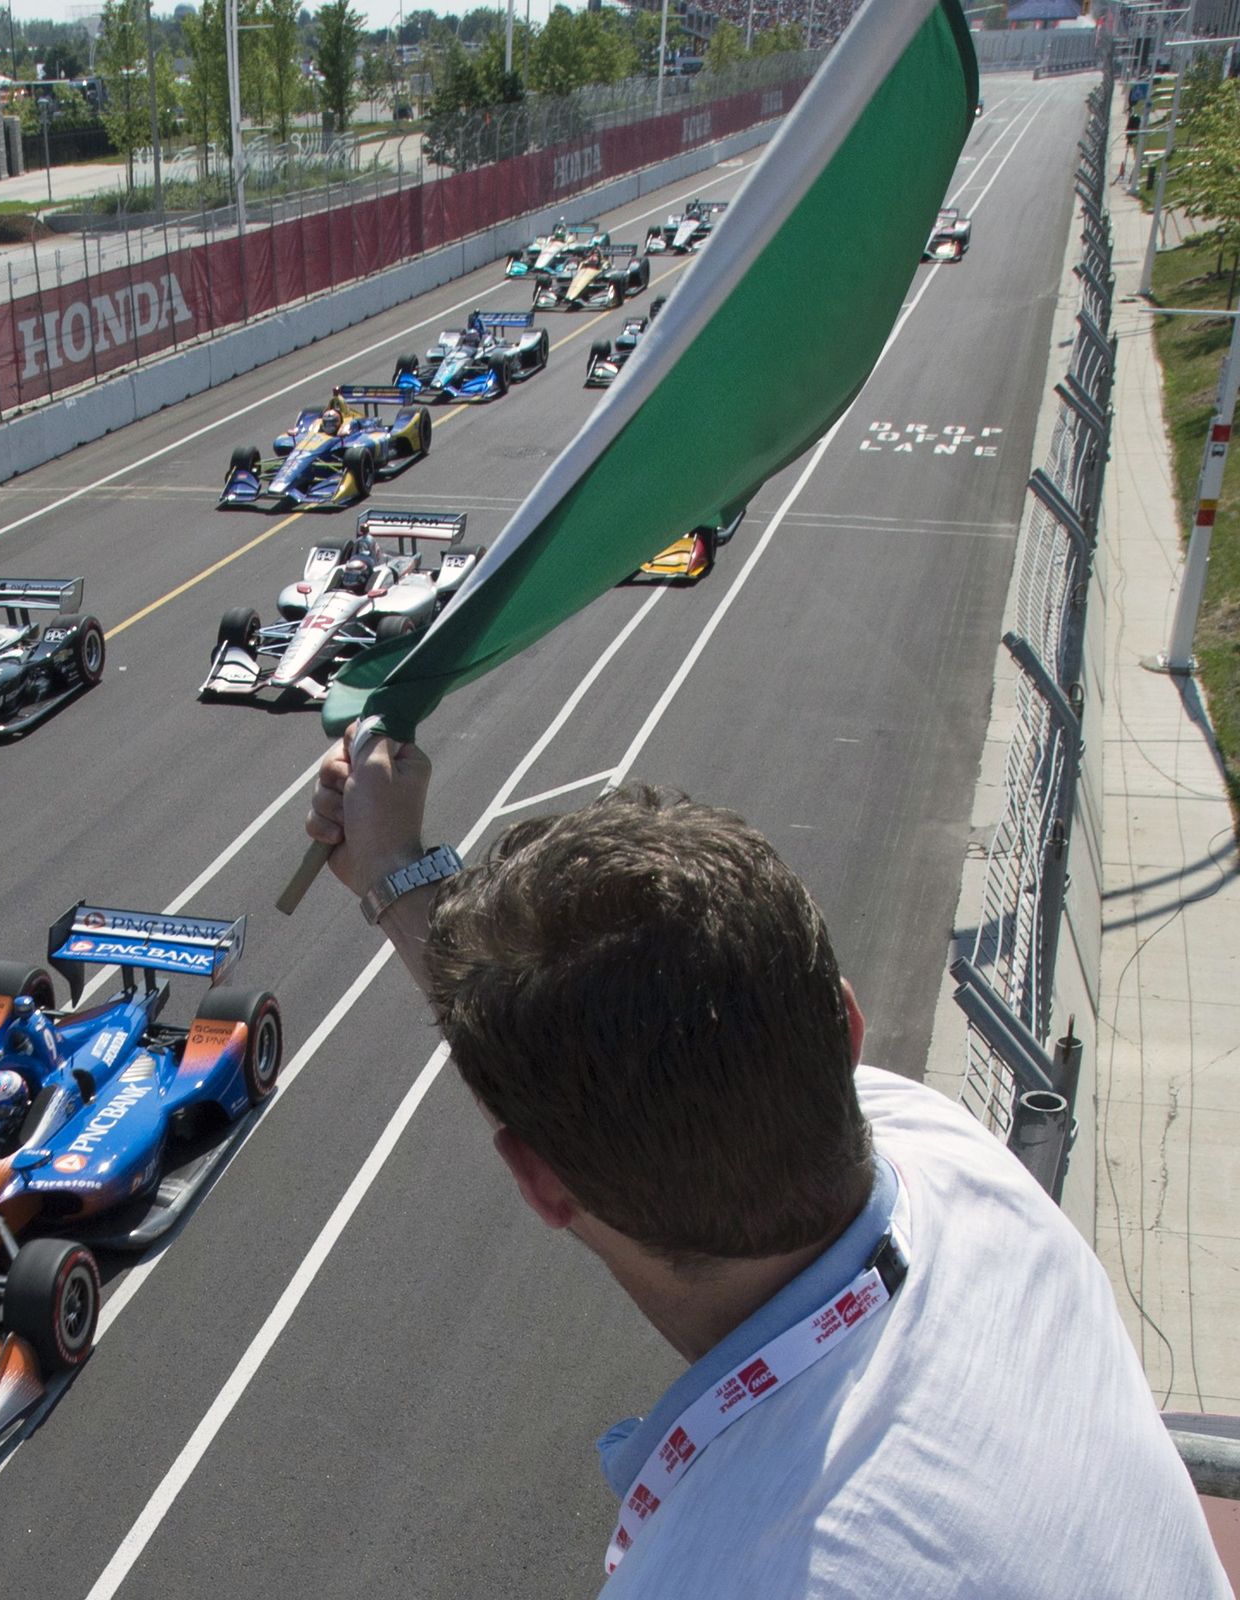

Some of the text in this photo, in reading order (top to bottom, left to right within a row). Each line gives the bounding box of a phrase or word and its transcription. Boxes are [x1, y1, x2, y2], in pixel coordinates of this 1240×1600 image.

[18, 273, 192, 379] HONDA
[869, 421, 1003, 437] DROP
[877, 431, 975, 445] OFF
[860, 440, 998, 456] LANE
[317, 550, 336, 561] PPG
[446, 557, 465, 567] PPG
[299, 615, 335, 632] 12
[43, 1028, 58, 1061] 9
[29, 1179, 103, 1190] Firestone
[821, 1308, 834, 1321] GET
[821, 1315, 839, 1330] WHO
[816, 1321, 842, 1344] PEOPLE
[723, 1377, 736, 1391] GET
[723, 1384, 742, 1400] WHO
[720, 1390, 746, 1413] PEOPLE
